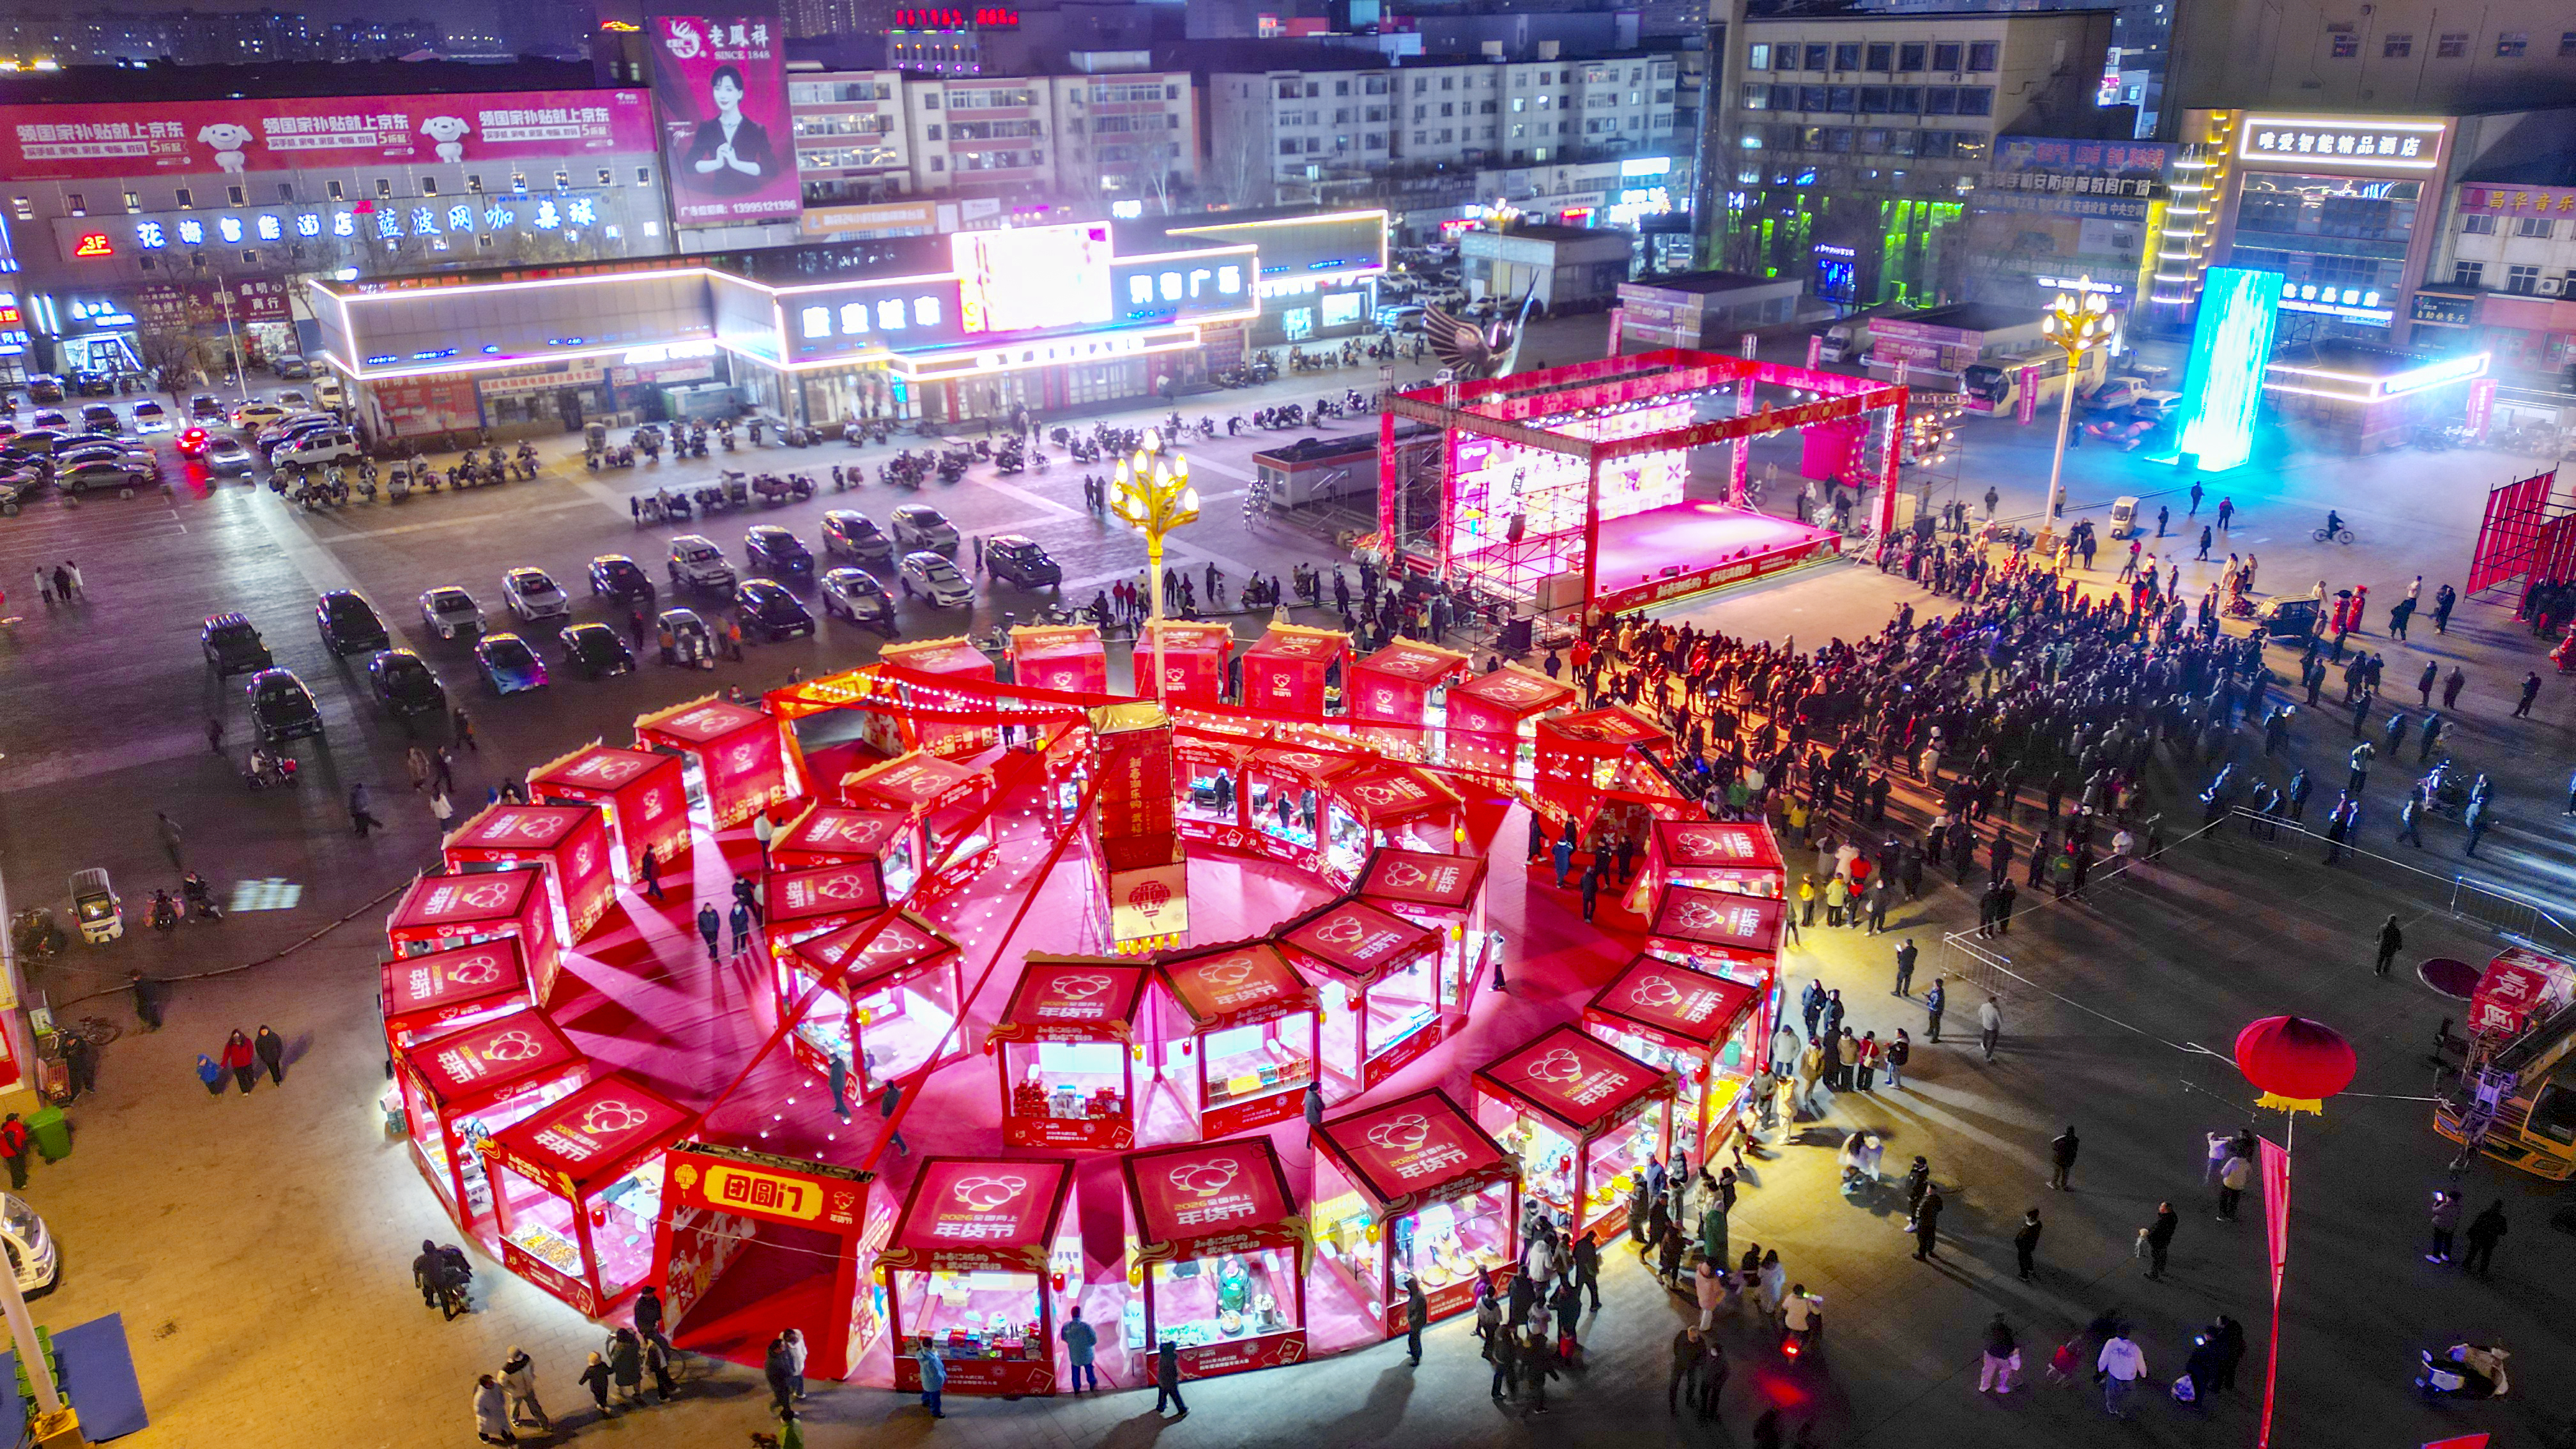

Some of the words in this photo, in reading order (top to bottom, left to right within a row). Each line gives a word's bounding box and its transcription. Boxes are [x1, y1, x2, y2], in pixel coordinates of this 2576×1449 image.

[714, 51, 744, 60] SINCE
[263, 114, 410, 134] 领国家补贴就上京东
[479, 107, 610, 126] 领国家补贴就上京东
[17, 121, 184, 142] 领国家补贴就上京东
[2258, 132, 2421, 157] 唯爱智能精品酒店
[2490, 192, 2575, 212] 昌华音乐
[84, 235, 107, 249] 3F
[251, 297, 279, 310] 商行
[1214, 989, 1278, 1006] 年货节
[1036, 1006, 1105, 1019] 年货节
[436, 1050, 475, 1085] 年货节
[1572, 1073, 1630, 1108] 年货节
[533, 1130, 592, 1163] 年货节
[1390, 1144, 1457, 1169] 2026全国网上
[1396, 1149, 1469, 1180] 年货节
[723, 1174, 803, 1213] 团圆门
[1174, 1194, 1252, 1211] 2026全国网上
[939, 1213, 1018, 1222] 2026全国网上
[1176, 1204, 1256, 1225] 年货节
[933, 1222, 1016, 1239] 年货节
